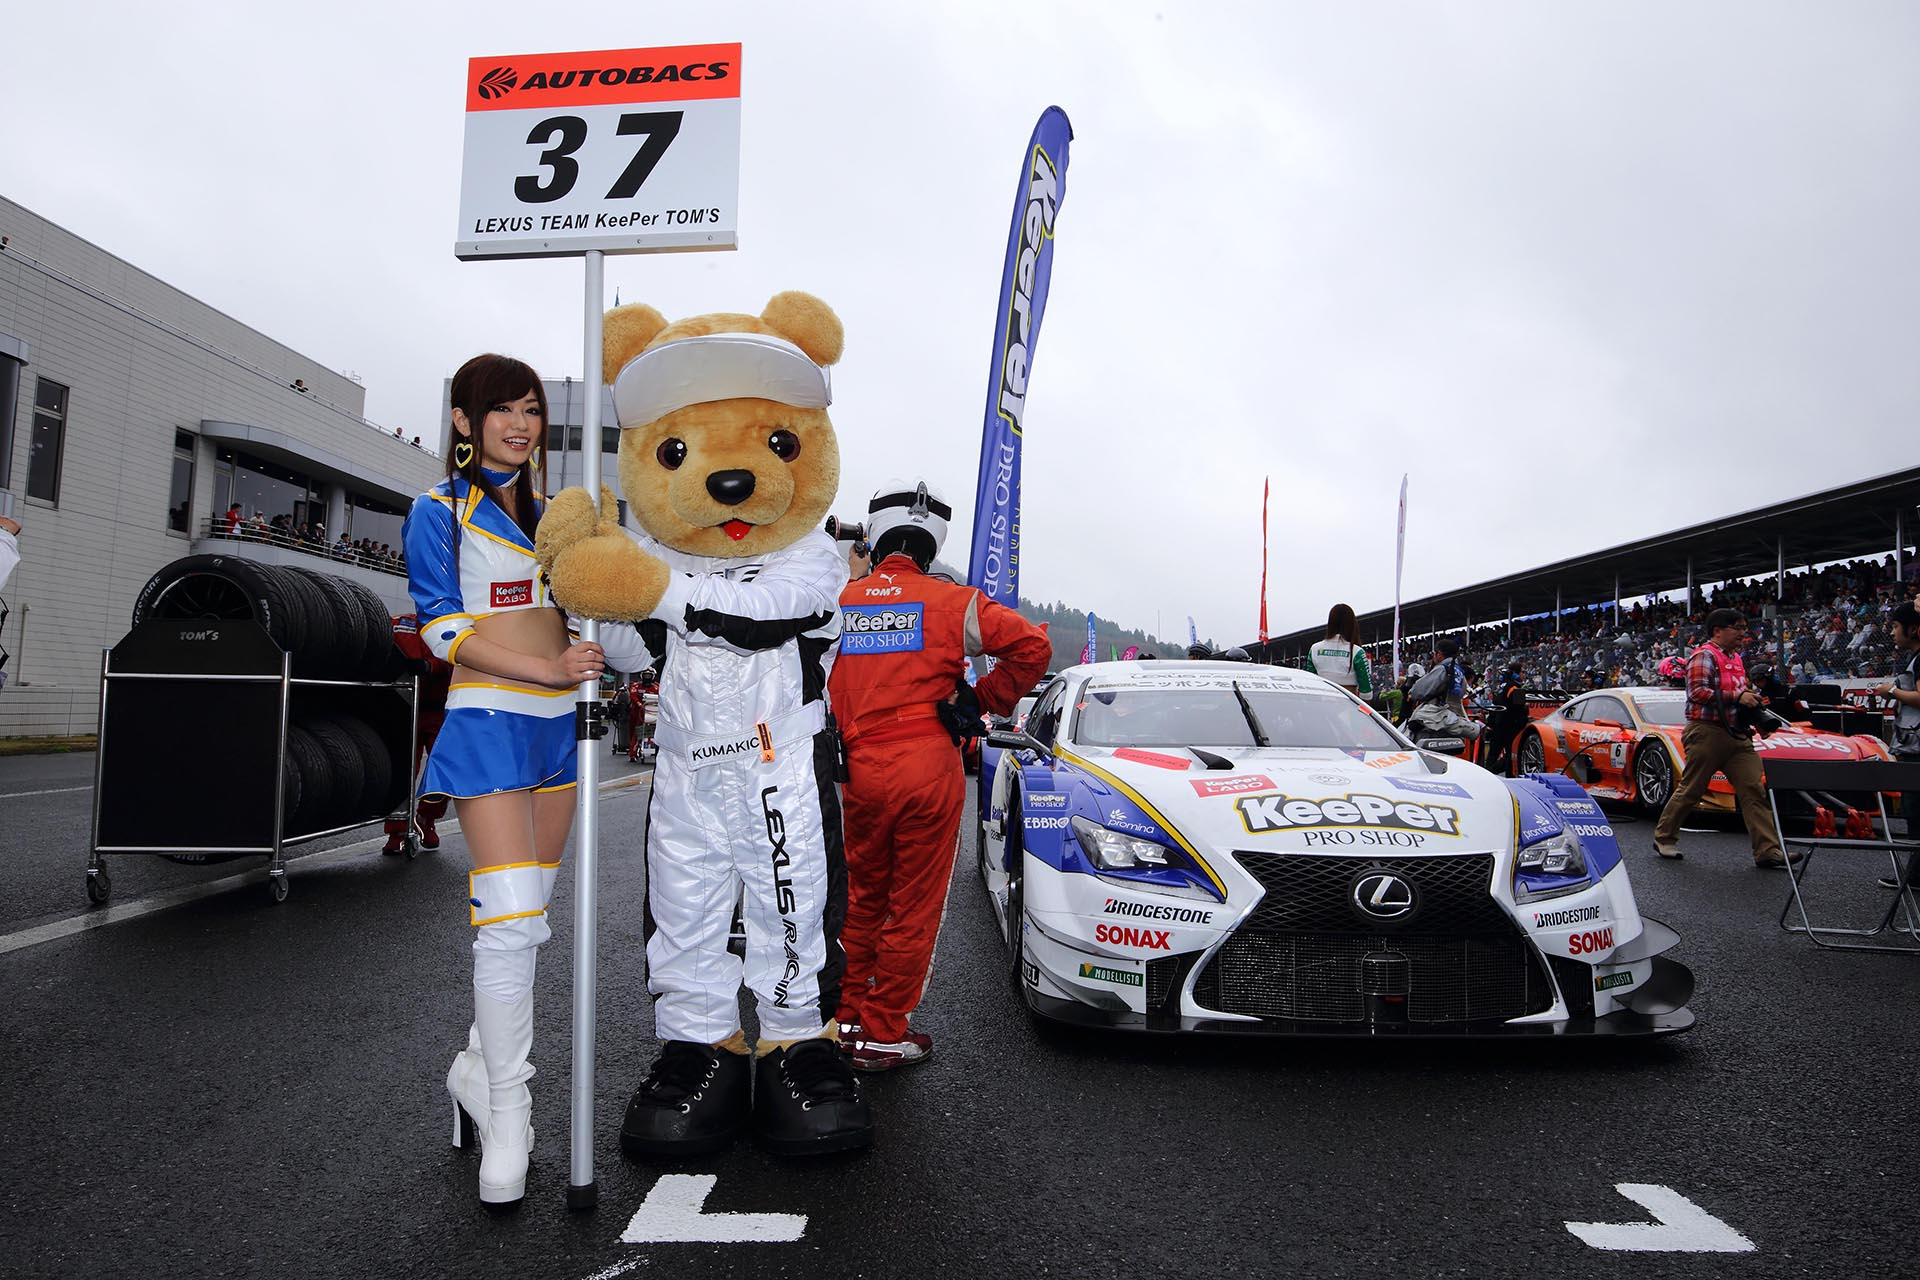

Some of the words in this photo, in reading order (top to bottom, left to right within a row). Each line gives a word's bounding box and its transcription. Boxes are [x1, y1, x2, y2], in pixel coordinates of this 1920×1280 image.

[519, 62, 730, 91] AUTOBACS
[514, 110, 684, 203] 37
[475, 216, 533, 233] LEXUS
[540, 214, 589, 230] TEAM
[595, 211, 659, 228] KeePer
[666, 208, 720, 224] TOM'S
[996, 441, 1015, 506] PRO
[984, 512, 1007, 598] SHOP
[496, 584, 528, 596] KeePer
[496, 593, 527, 604] LABO
[865, 586, 902, 597] TOM'S
[844, 611, 919, 633] KeePer
[180, 629, 219, 641] TOM'S
[846, 635, 875, 648] PRO
[877, 632, 915, 648] SHOP
[692, 737, 760, 761] KUMAKIC
[1615, 744, 1622, 757] 6
[1204, 776, 1260, 787] KeePer
[1206, 781, 1263, 793] LABO
[1029, 794, 1065, 802] KeePer
[1556, 801, 1594, 811] KeePer
[1024, 817, 1069, 829] EBBRO
[1240, 794, 1459, 834] KeePer
[1108, 820, 1155, 834] promina
[1523, 824, 1558, 840] promina
[1304, 830, 1356, 846] PRO
[1361, 832, 1425, 848] SHOP
[761, 785, 796, 915] LEXUS
[1104, 899, 1214, 924] BRIDGESTONE
[1534, 906, 1600, 928] BRIDGESTONE
[1095, 924, 1171, 950] SONAX
[1569, 927, 1616, 955] SONAX
[774, 918, 800, 1009] RACIN
[1094, 968, 1140, 985] MODELLISTA
